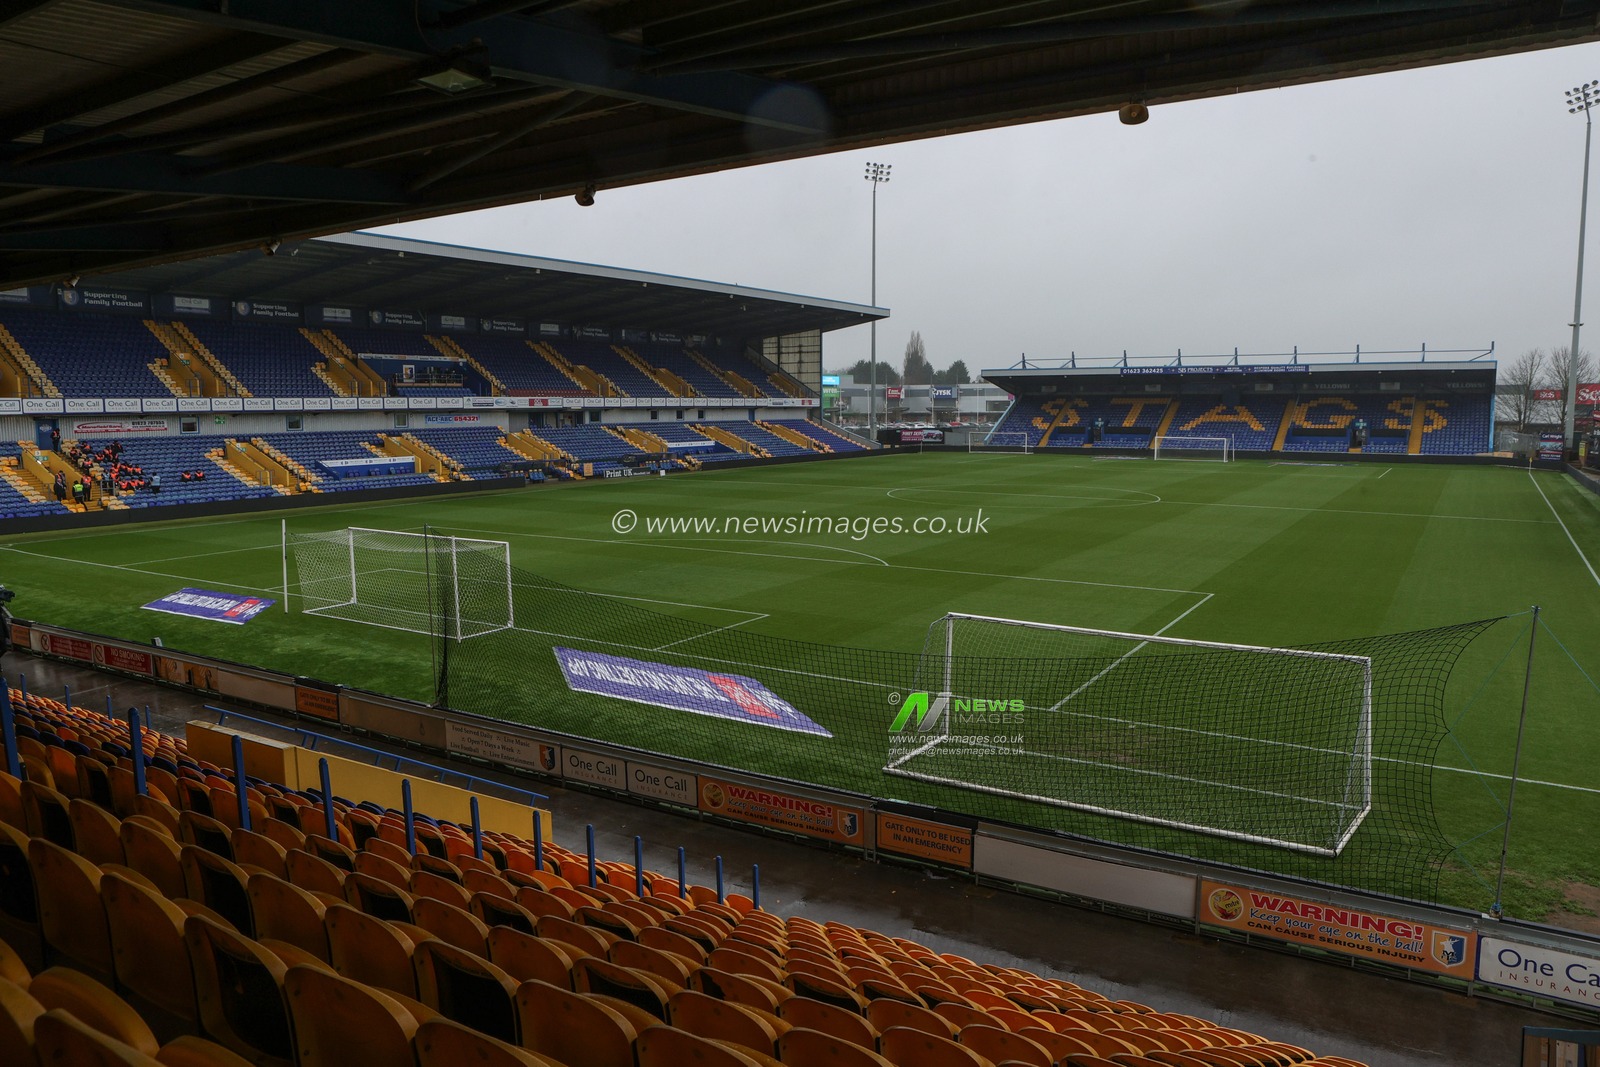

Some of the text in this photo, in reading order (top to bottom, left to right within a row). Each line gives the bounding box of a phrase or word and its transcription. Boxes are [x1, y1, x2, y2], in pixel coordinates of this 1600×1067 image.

[84, 291, 127, 300] Supporting
[84, 298, 110, 306] Family
[253, 303, 287, 311] Supporting
[26, 400, 60, 408] One Call
[1539, 391, 1555, 399] ScS
[1578, 388, 1600, 401] Sc
[1031, 397, 1448, 433] STAGS
[606, 469, 622, 478] Print
[110, 647, 145, 663] NO SMOKING
[452, 725, 530, 748] Food Served Daily Live Music
[467, 737, 481, 746] Open
[484, 741, 497, 750] Days
[501, 744, 515, 753] Week
[450, 742, 535, 767] Live Football Live Entertainment
[569, 755, 617, 776] One Call
[570, 768, 617, 784] INSURANCE
[634, 769, 687, 792] One Call
[636, 785, 687, 800] INSURANCE
[727, 785, 833, 818] WARNING!
[727, 807, 835, 835] CAN CAUSE SERIOUS INJURY
[728, 797, 833, 827] Keep your eye on the ball!
[885, 821, 971, 846] GATE ONLY TO BE USED
[893, 832, 962, 854] IN AN EMERGENCY
[1224, 900, 1240, 909] mitre
[1249, 892, 1424, 942] WARNING!
[1249, 908, 1424, 953] Keep your eye on the ball!
[1247, 921, 1426, 963] CAN CAUSE SERIOUS INJURY
[1497, 948, 1554, 977] One
